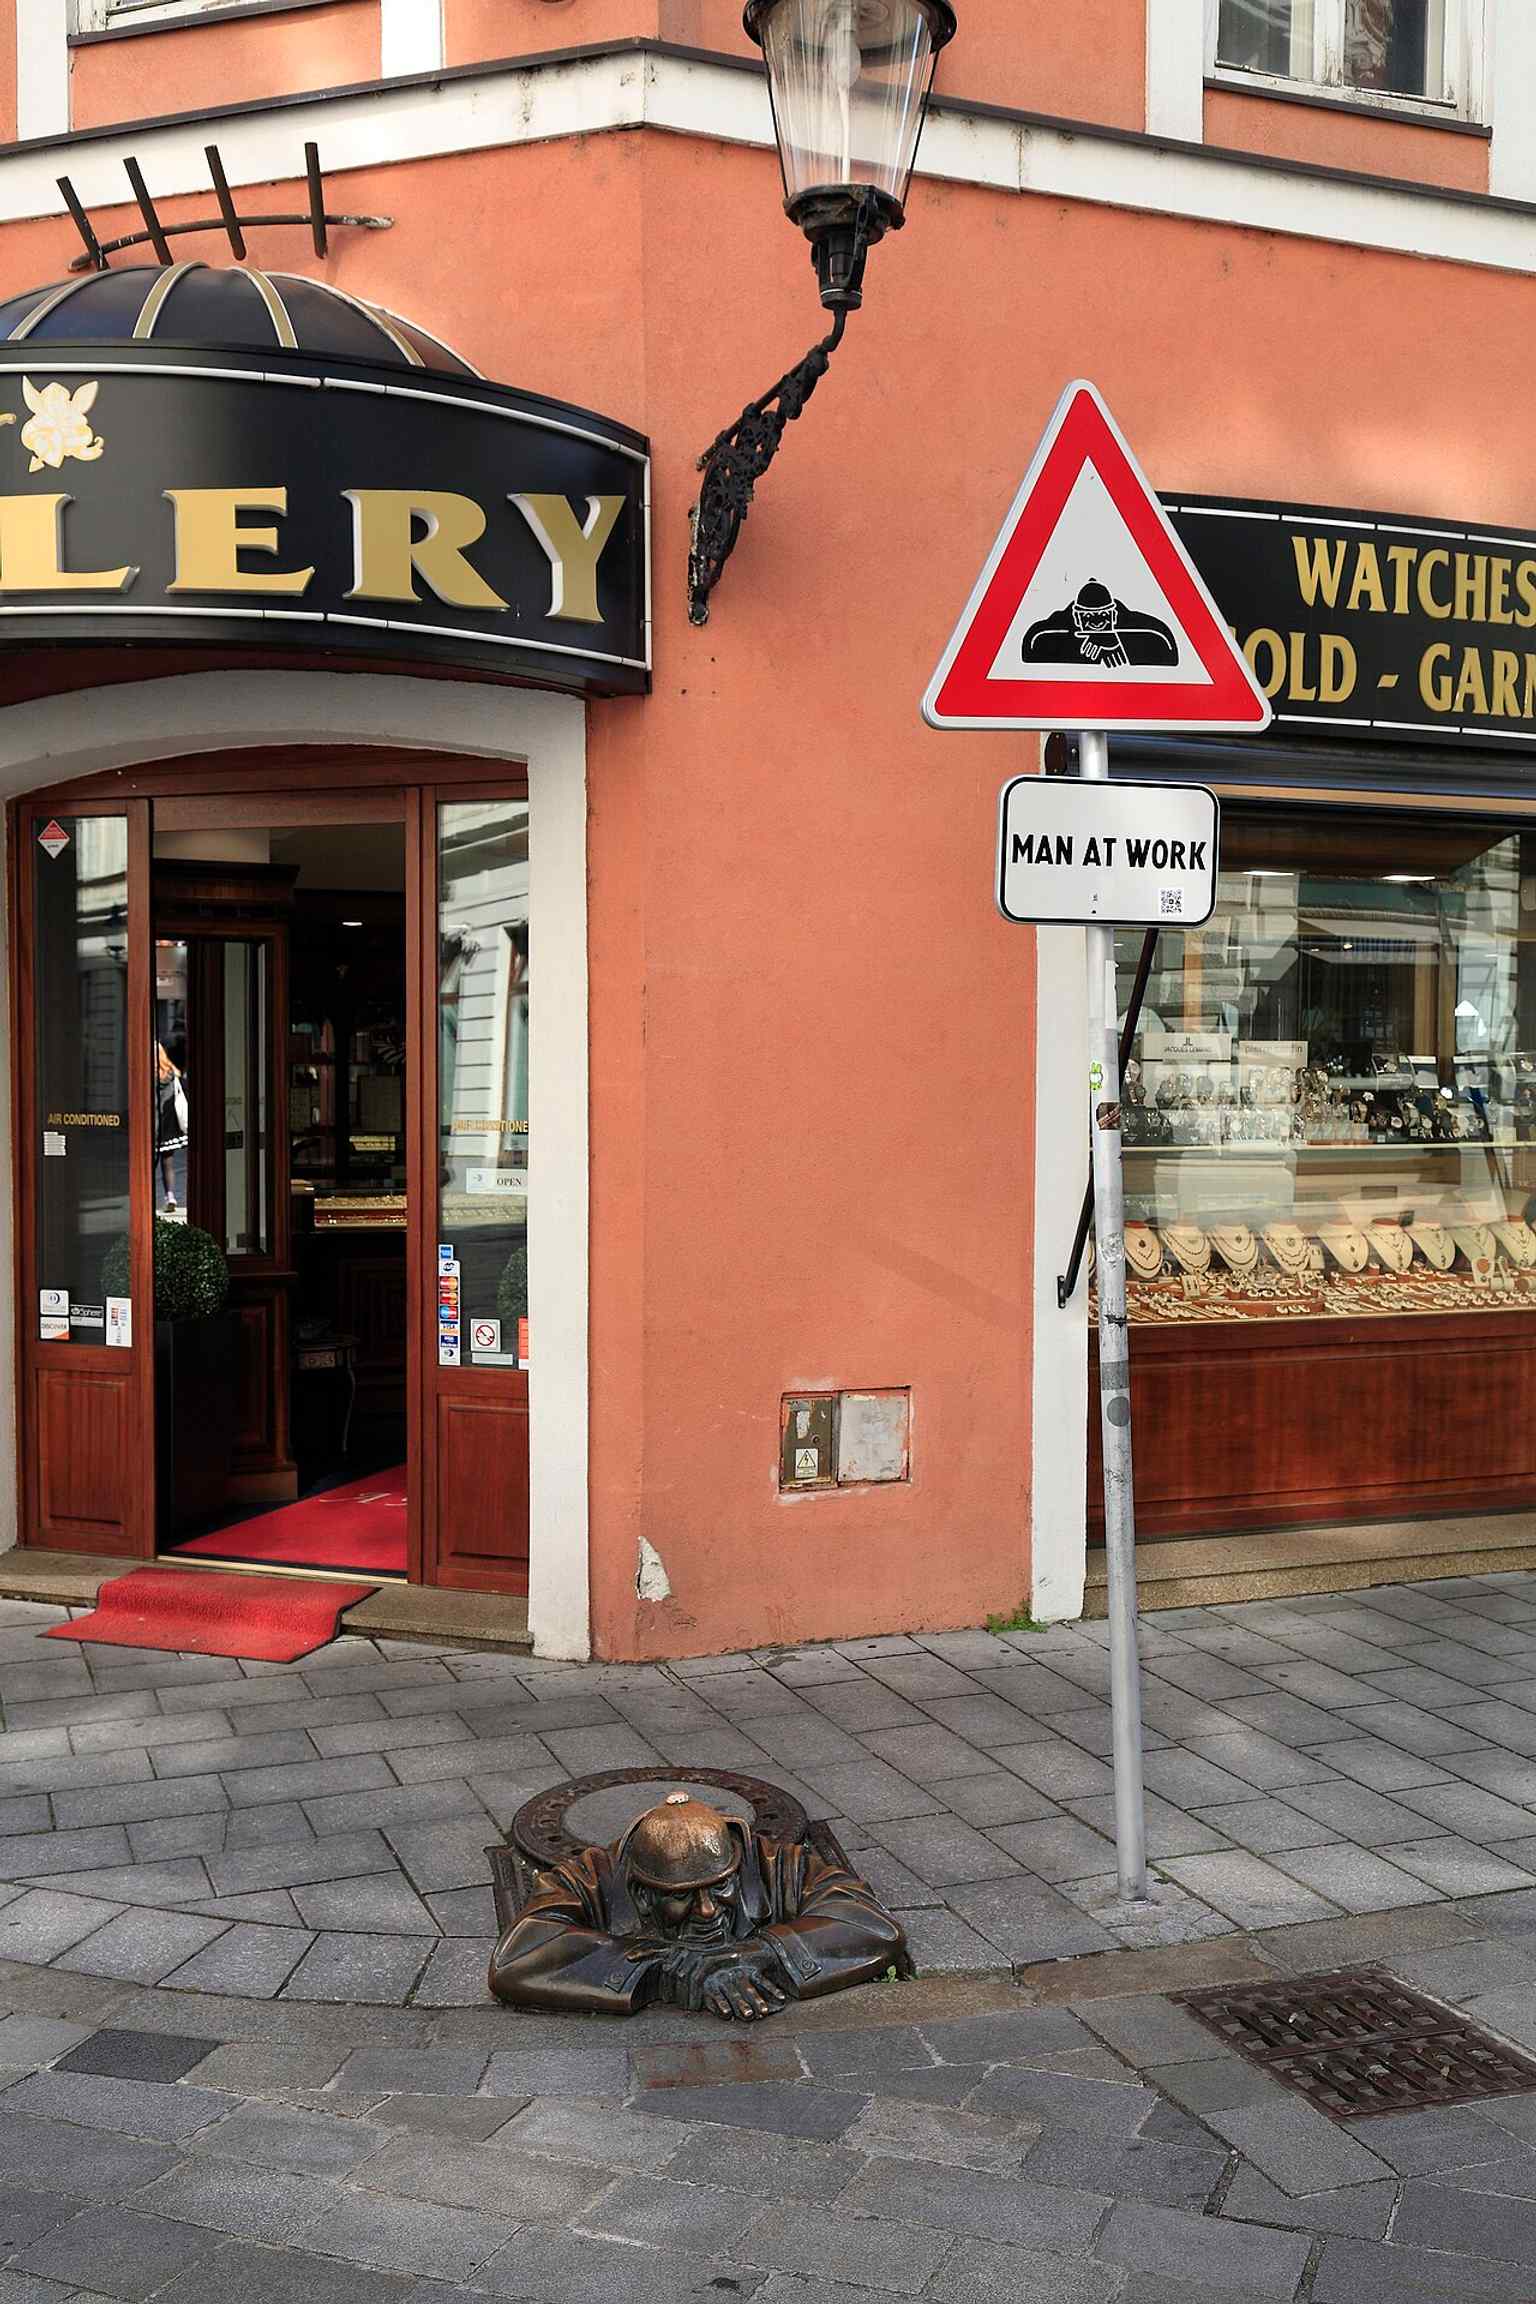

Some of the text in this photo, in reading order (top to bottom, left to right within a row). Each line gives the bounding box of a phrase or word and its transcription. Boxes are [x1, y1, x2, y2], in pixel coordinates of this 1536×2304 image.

[0, 486, 627, 623] LERY
[1291, 536, 1536, 628] WATCHES
[1228, 626, 1358, 703] OLD
[1012, 834, 1206, 870] MAN AT WORK
[48, 1113, 120, 1127] AIR CONDITIONED
[496, 1176, 521, 1186] OPEN
